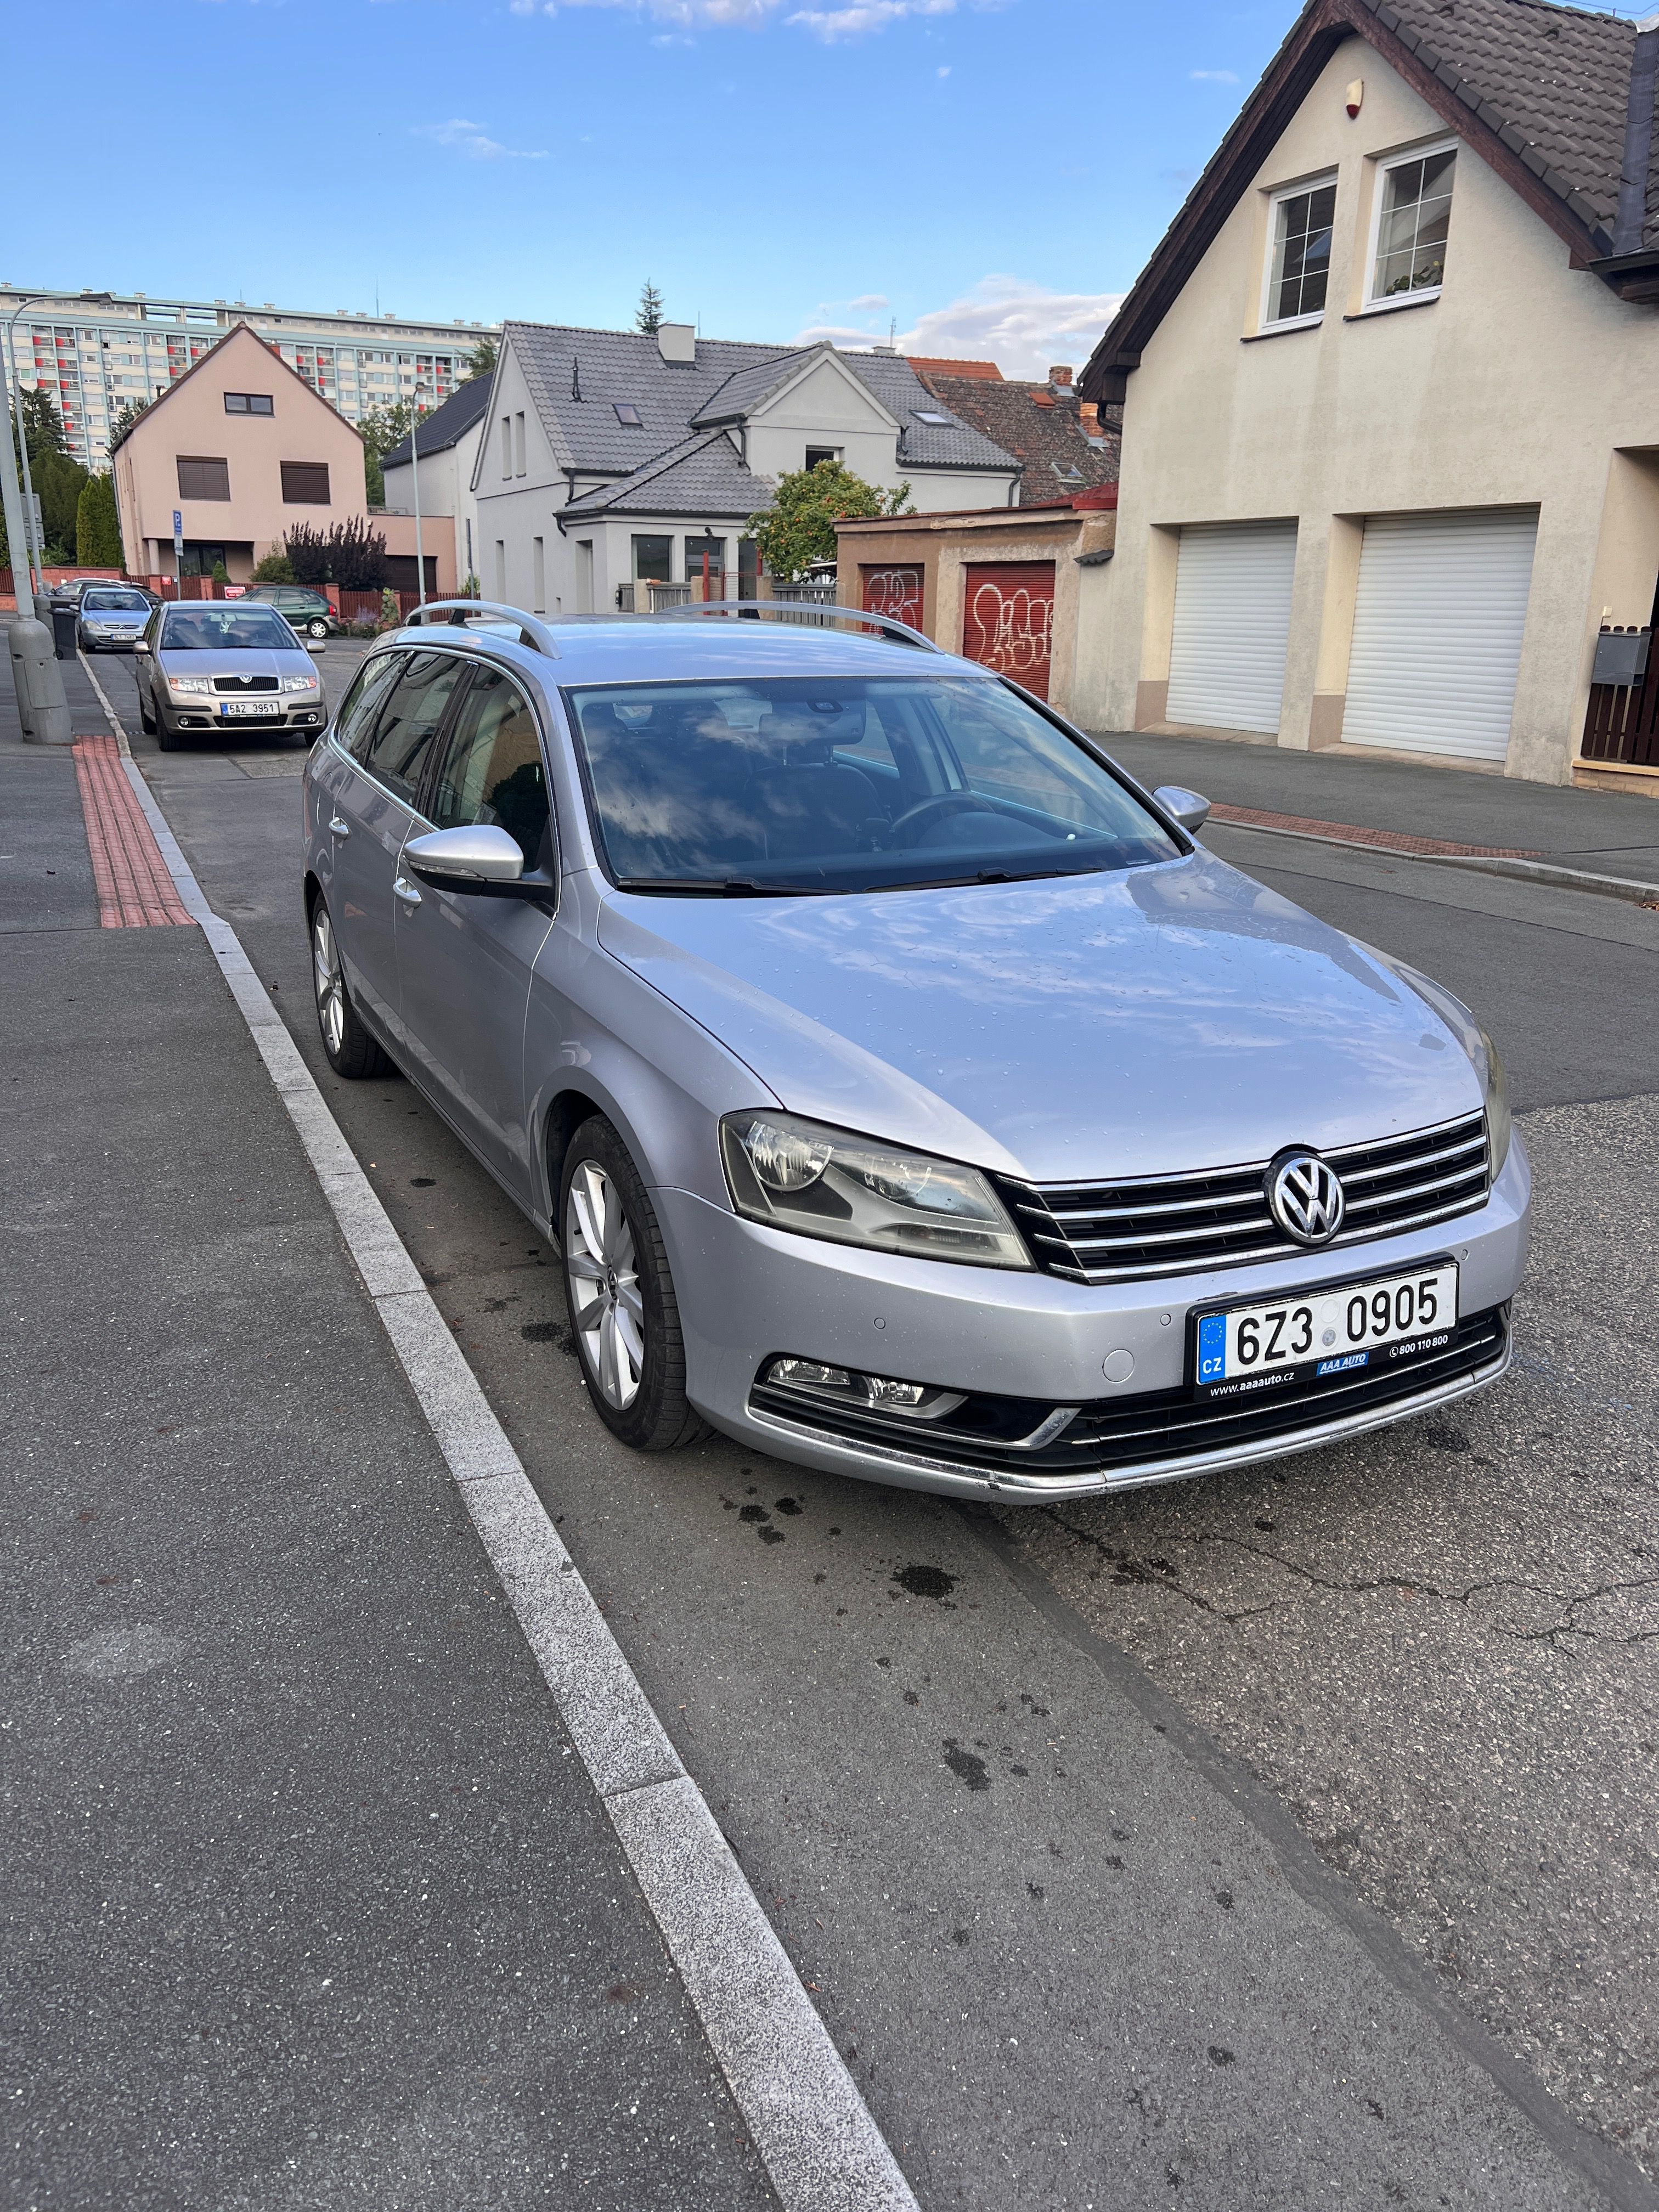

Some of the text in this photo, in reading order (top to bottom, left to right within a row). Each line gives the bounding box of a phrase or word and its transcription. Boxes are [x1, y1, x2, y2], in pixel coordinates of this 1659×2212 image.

[229, 704, 274, 714] 5A2 3951
[1276, 1159, 1342, 1241] VW
[1237, 1278, 1438, 1365] 6Z3 0905
[1399, 1335, 1448, 1355] 800 110 800
[1203, 1357, 1222, 1374] CZ
[1320, 1353, 1366, 1372] AAA AUTO
[1210, 1372, 1295, 1397] www.aaaauto.cz
